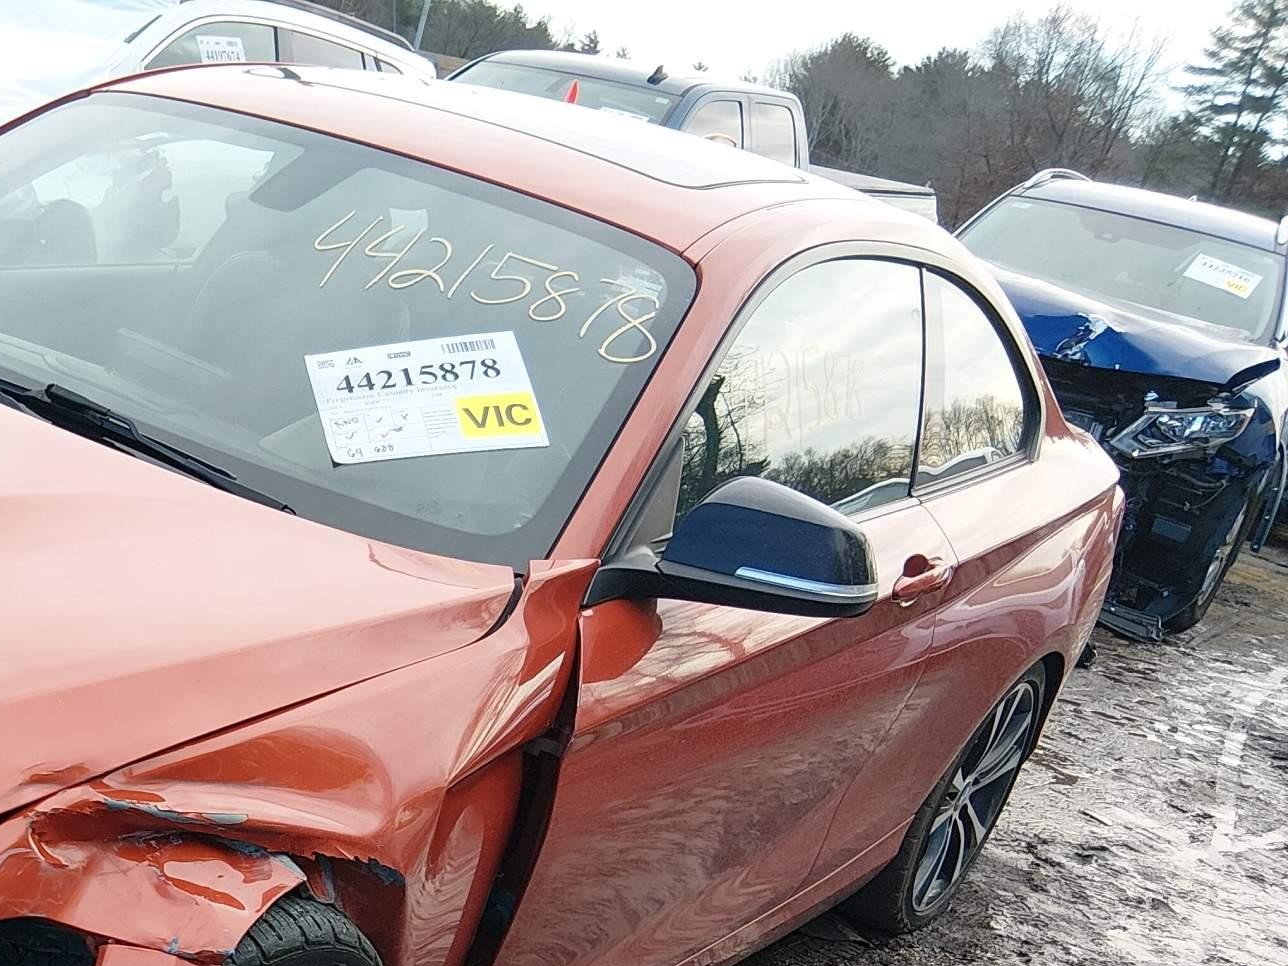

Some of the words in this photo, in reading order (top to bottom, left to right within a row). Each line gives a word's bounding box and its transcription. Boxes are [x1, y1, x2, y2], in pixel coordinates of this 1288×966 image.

[314, 210, 660, 364] 44215878
[1227, 281, 1247, 292] VIC
[336, 358, 502, 394] 44215878
[462, 403, 532, 429] VIC
